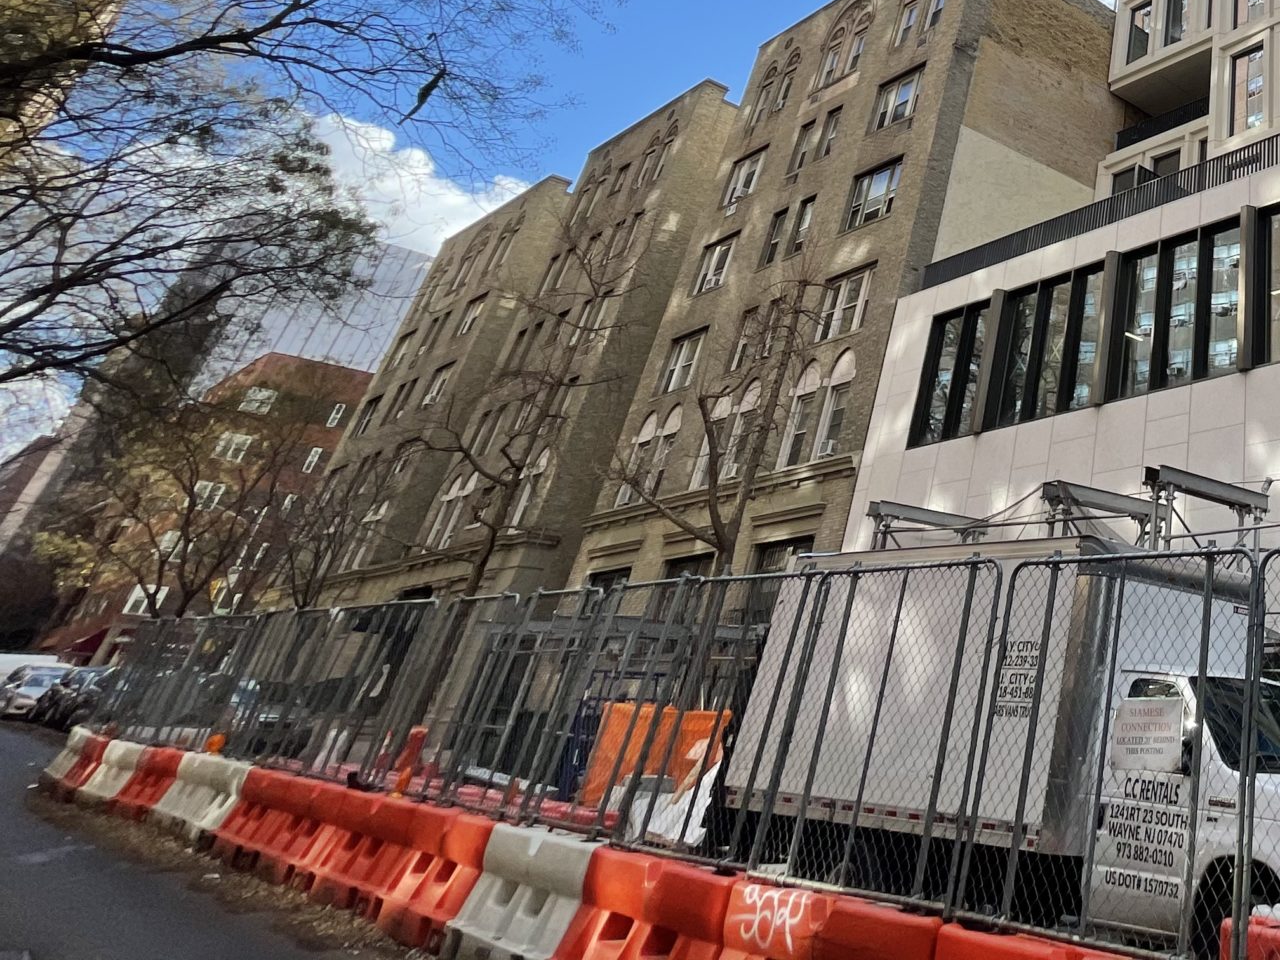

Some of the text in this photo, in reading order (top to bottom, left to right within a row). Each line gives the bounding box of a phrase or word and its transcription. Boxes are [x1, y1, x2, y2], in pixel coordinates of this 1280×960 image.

[1017, 641, 1035, 653] CITY
[1003, 655, 1039, 667] 12-239-33
[1009, 673, 1029, 685] CITY
[999, 686, 1034, 698] 18-451-88
[1129, 707, 1166, 718] SIAMESE
[1121, 722, 1173, 733] CONNECTION
[1140, 780, 1180, 804] RENTALS
[1142, 808, 1154, 824] 23
[1155, 811, 1189, 830] SOUTH
[1144, 826, 1156, 843] NJ
[1157, 829, 1184, 849] 07470
[1116, 841, 1132, 860] 973
[1105, 870, 1116, 885] US
[1118, 872, 1141, 891] DOT#
